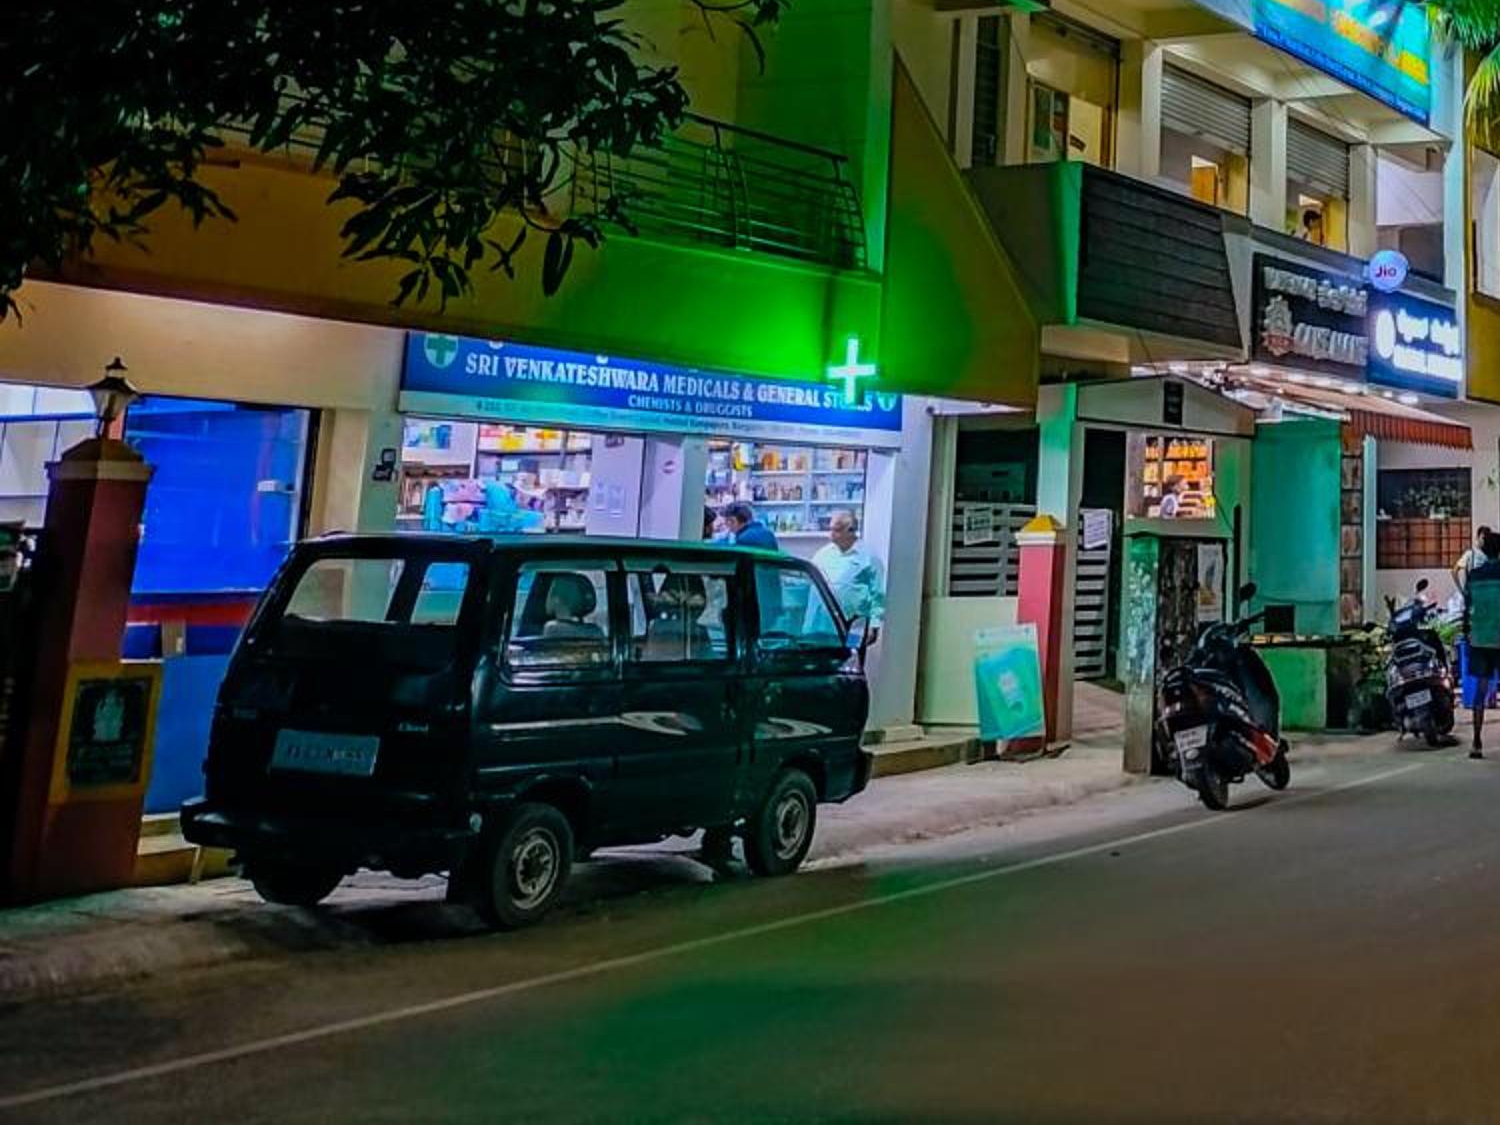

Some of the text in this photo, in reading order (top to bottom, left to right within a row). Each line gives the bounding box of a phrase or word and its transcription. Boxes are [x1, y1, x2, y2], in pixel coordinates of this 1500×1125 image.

[1375, 267, 1398, 279] Jio
[465, 353, 500, 376] SRI
[504, 356, 659, 393] VENKATESHWARA
[664, 373, 740, 401] MEDICALS
[741, 383, 753, 401] &
[757, 384, 820, 408] GENERAL
[627, 395, 682, 412] CHEMISTS
